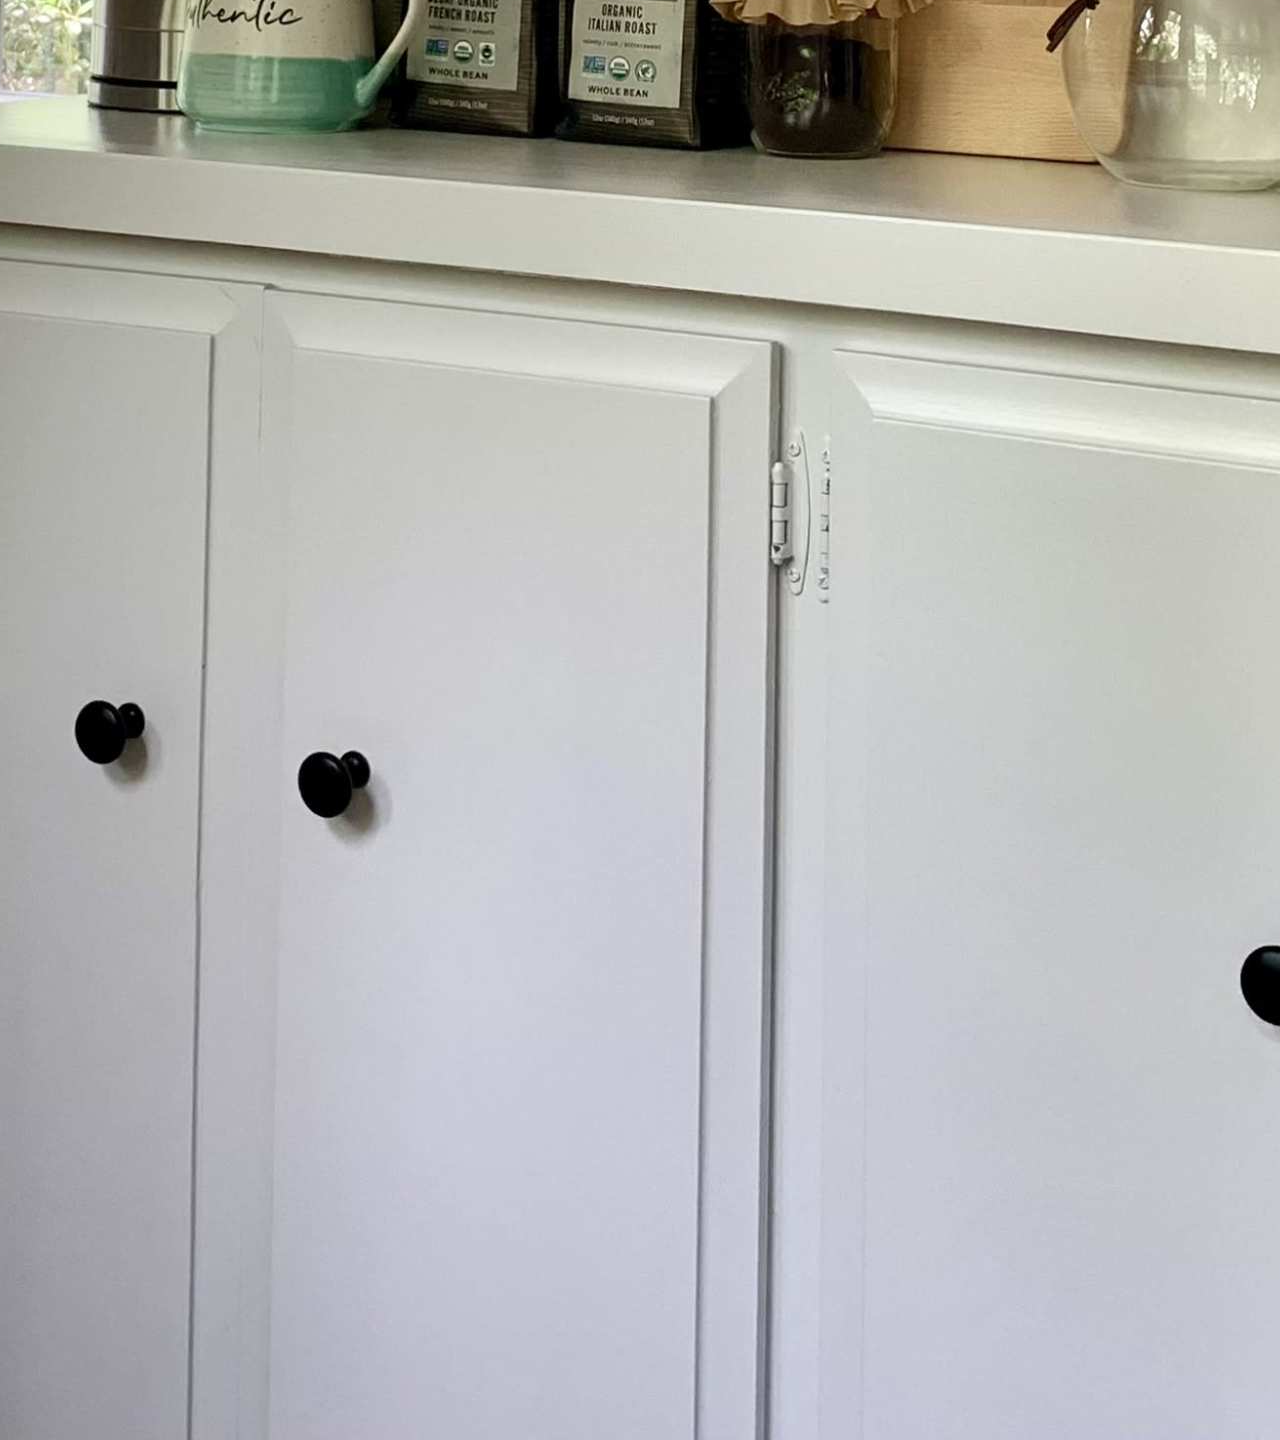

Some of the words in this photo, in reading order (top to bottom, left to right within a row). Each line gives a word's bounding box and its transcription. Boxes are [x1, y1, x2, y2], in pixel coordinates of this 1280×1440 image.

[428, 5, 462, 21] FRENCH
[464, 9, 497, 24] ROAST
[601, 3, 643, 19] ORGANIC
[587, 18, 622, 33] ITALIAN
[624, 21, 657, 35] ROAST
[428, 67, 460, 78] WHOLE
[462, 70, 488, 80] BEAN
[588, 85, 621, 96] WHOLE
[623, 88, 649, 98] BEAN
